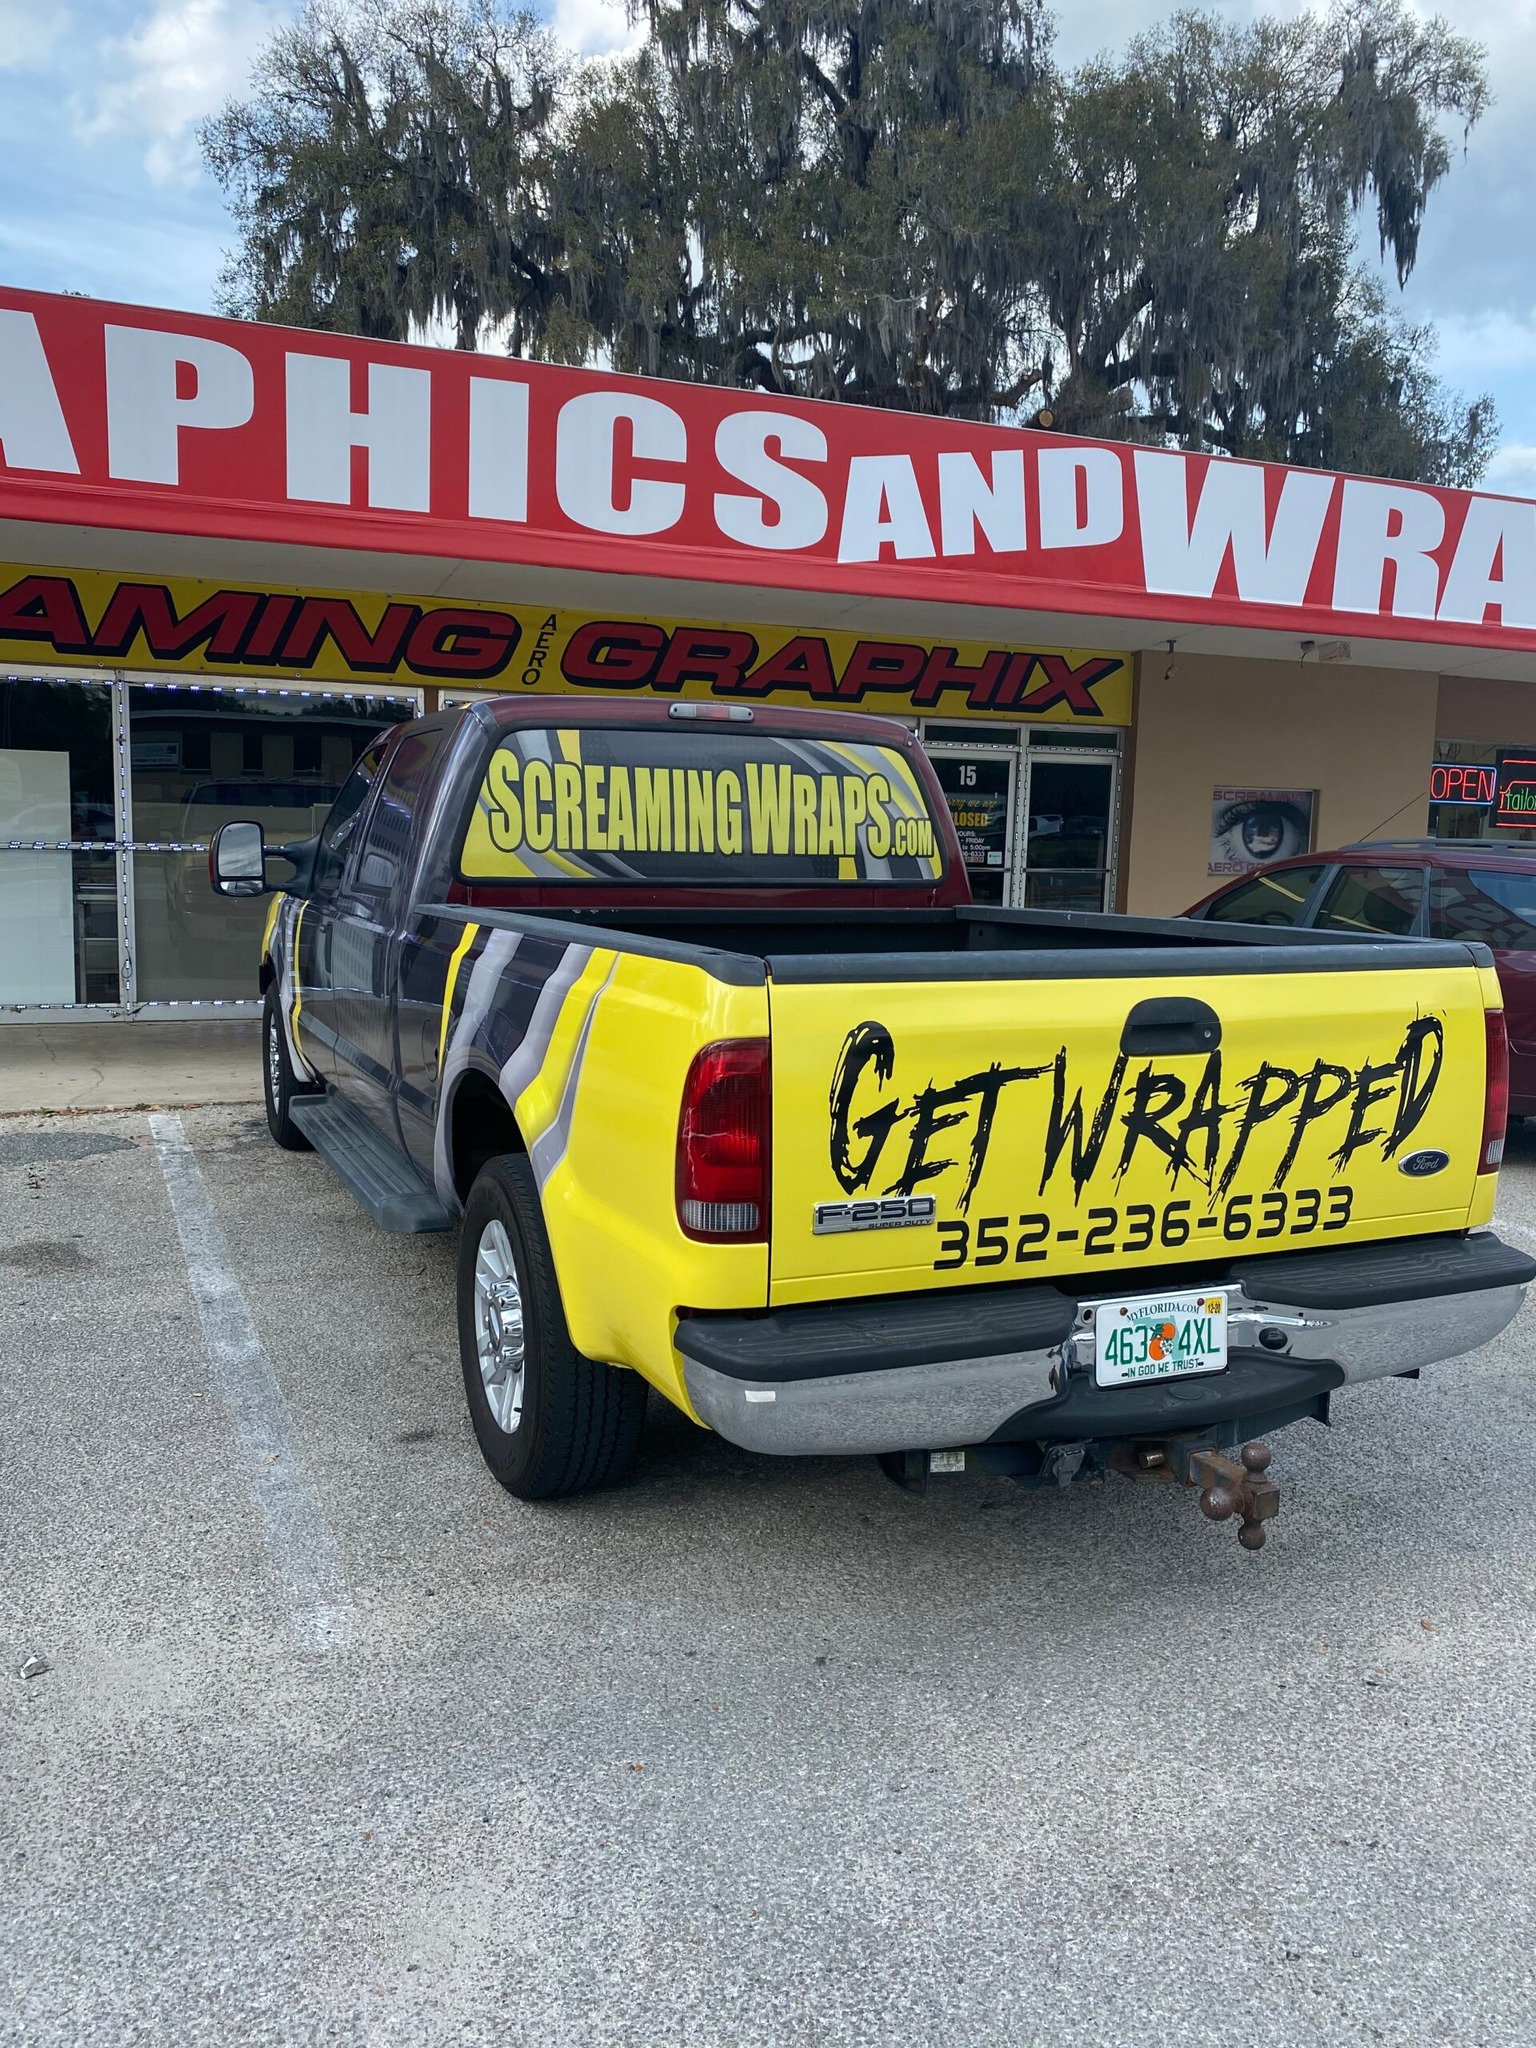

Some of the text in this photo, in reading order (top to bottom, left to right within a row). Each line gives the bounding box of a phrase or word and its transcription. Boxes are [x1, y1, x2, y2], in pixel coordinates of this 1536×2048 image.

[521, 613, 558, 686] AERO
[560, 620, 1124, 717] GRAPHIX
[959, 765, 977, 786] 15
[1430, 768, 1494, 801] OPEN
[1505, 787, 1536, 811] tailo
[951, 812, 988, 827] LOSED
[1413, 1155, 1440, 1170] Ford
[933, 1185, 1354, 1271] 352-236-6333
[1105, 1317, 1220, 1366] 463 4XL
[1127, 1358, 1199, 1378] IN GOD WE TRUST
